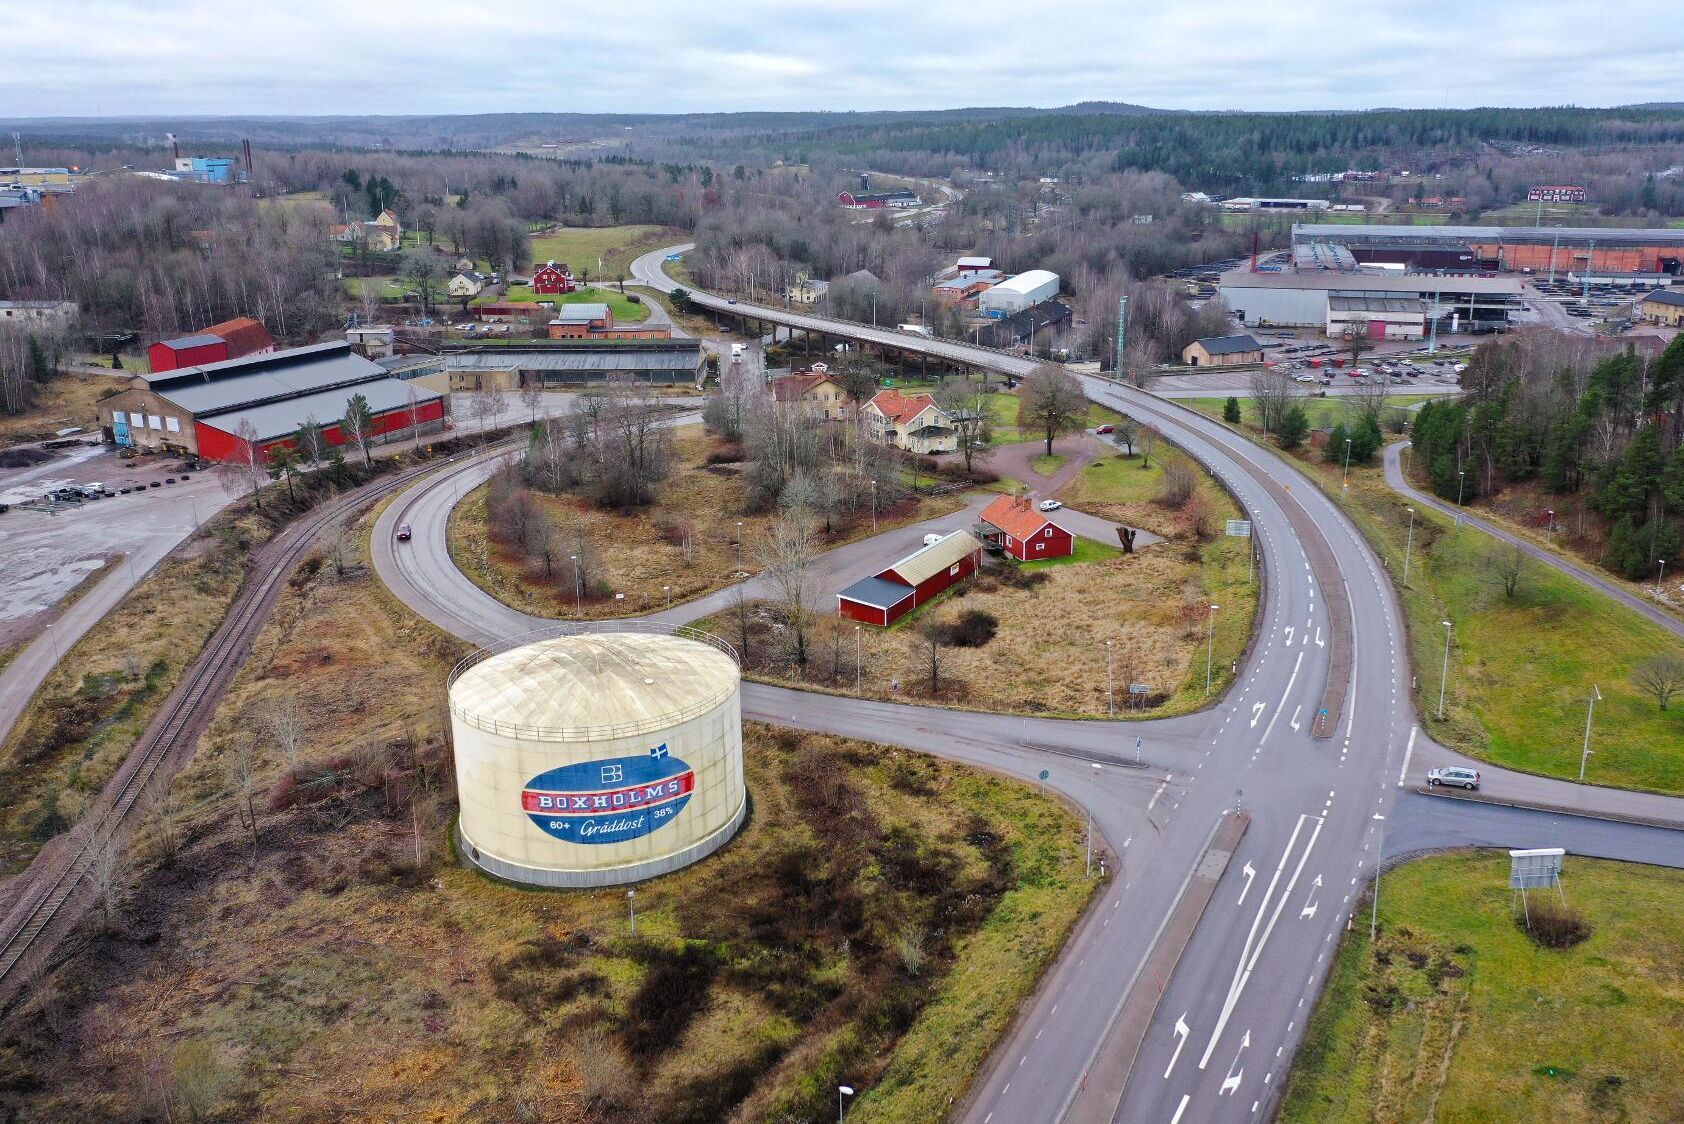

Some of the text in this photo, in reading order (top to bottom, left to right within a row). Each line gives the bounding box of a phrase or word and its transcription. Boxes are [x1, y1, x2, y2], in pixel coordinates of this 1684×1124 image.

[538, 780, 679, 808] BOXHOLMS
[549, 806, 674, 837] 60+ Gräddost 38%
